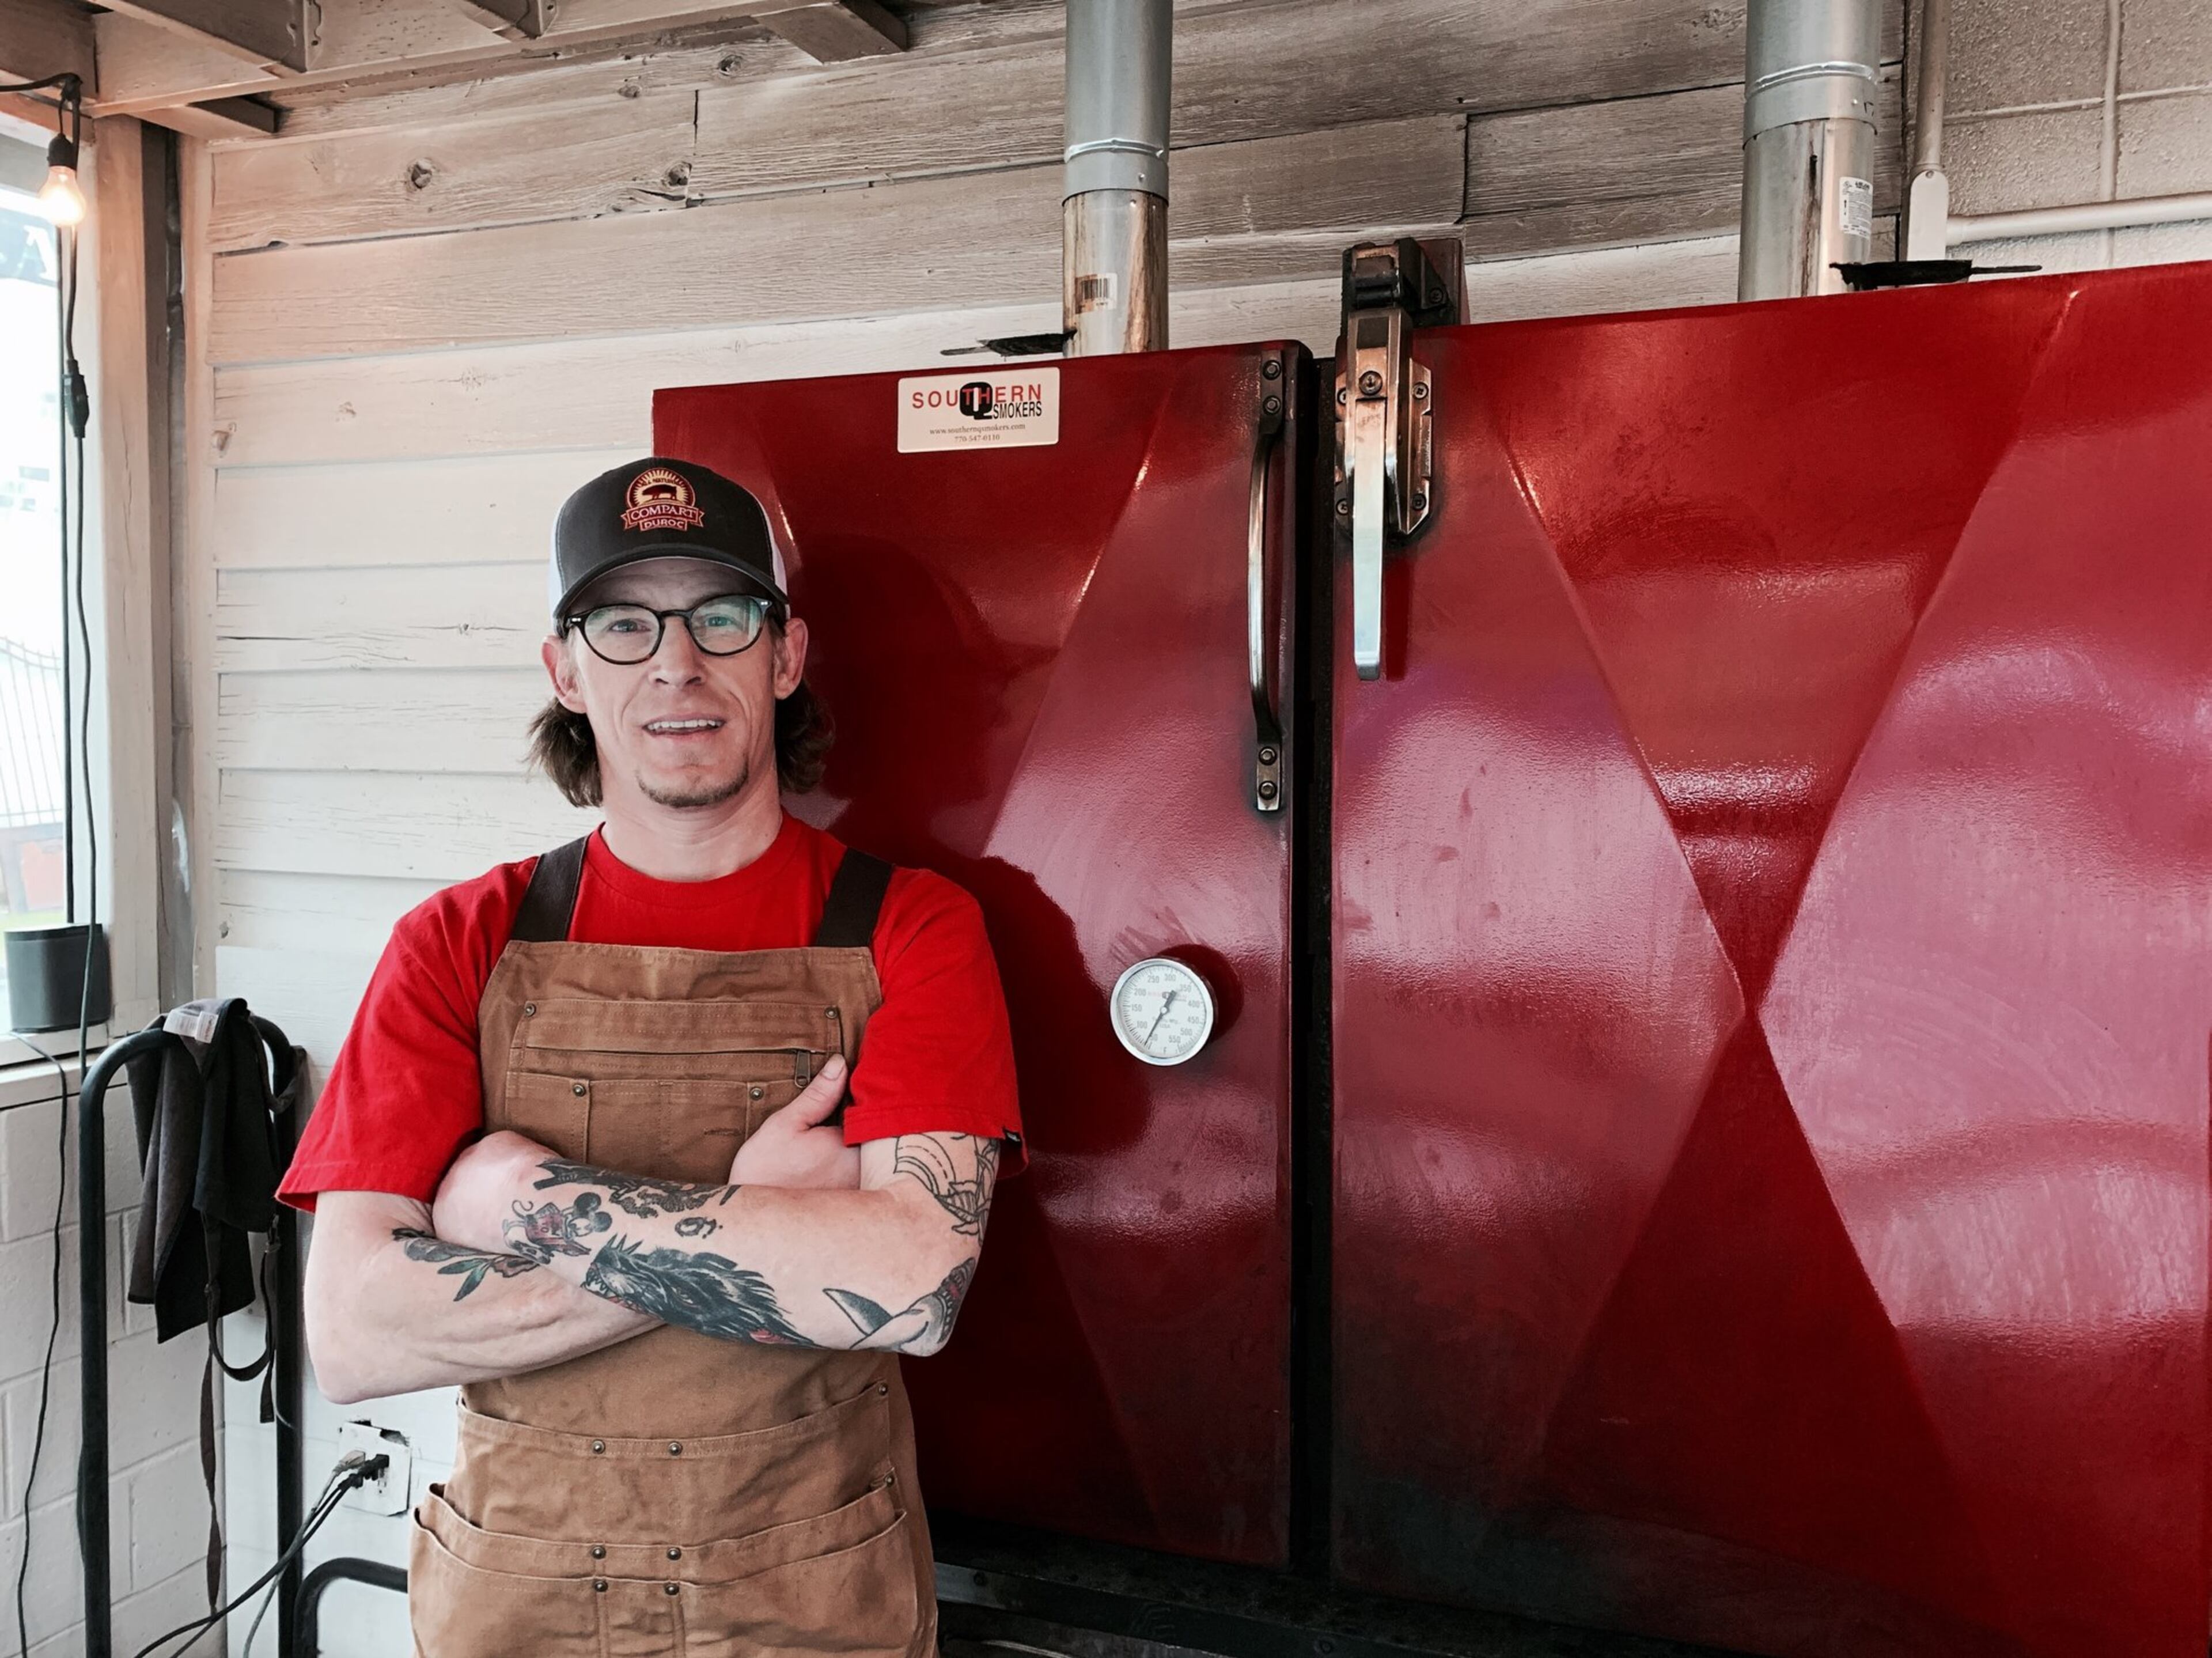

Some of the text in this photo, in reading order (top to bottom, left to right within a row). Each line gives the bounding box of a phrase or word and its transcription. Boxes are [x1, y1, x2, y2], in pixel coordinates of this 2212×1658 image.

[912, 384, 1041, 409] SOUTHERN
[993, 400, 1042, 419] SMOKERS
[929, 423, 1026, 435] www.southernqsmokers.com
[630, 505, 696, 520] COMPART
[644, 518, 684, 529] DUROC
[1147, 975, 1160, 983] 250
[1134, 988, 1146, 996] 200
[1137, 1021, 1147, 1029] 100
